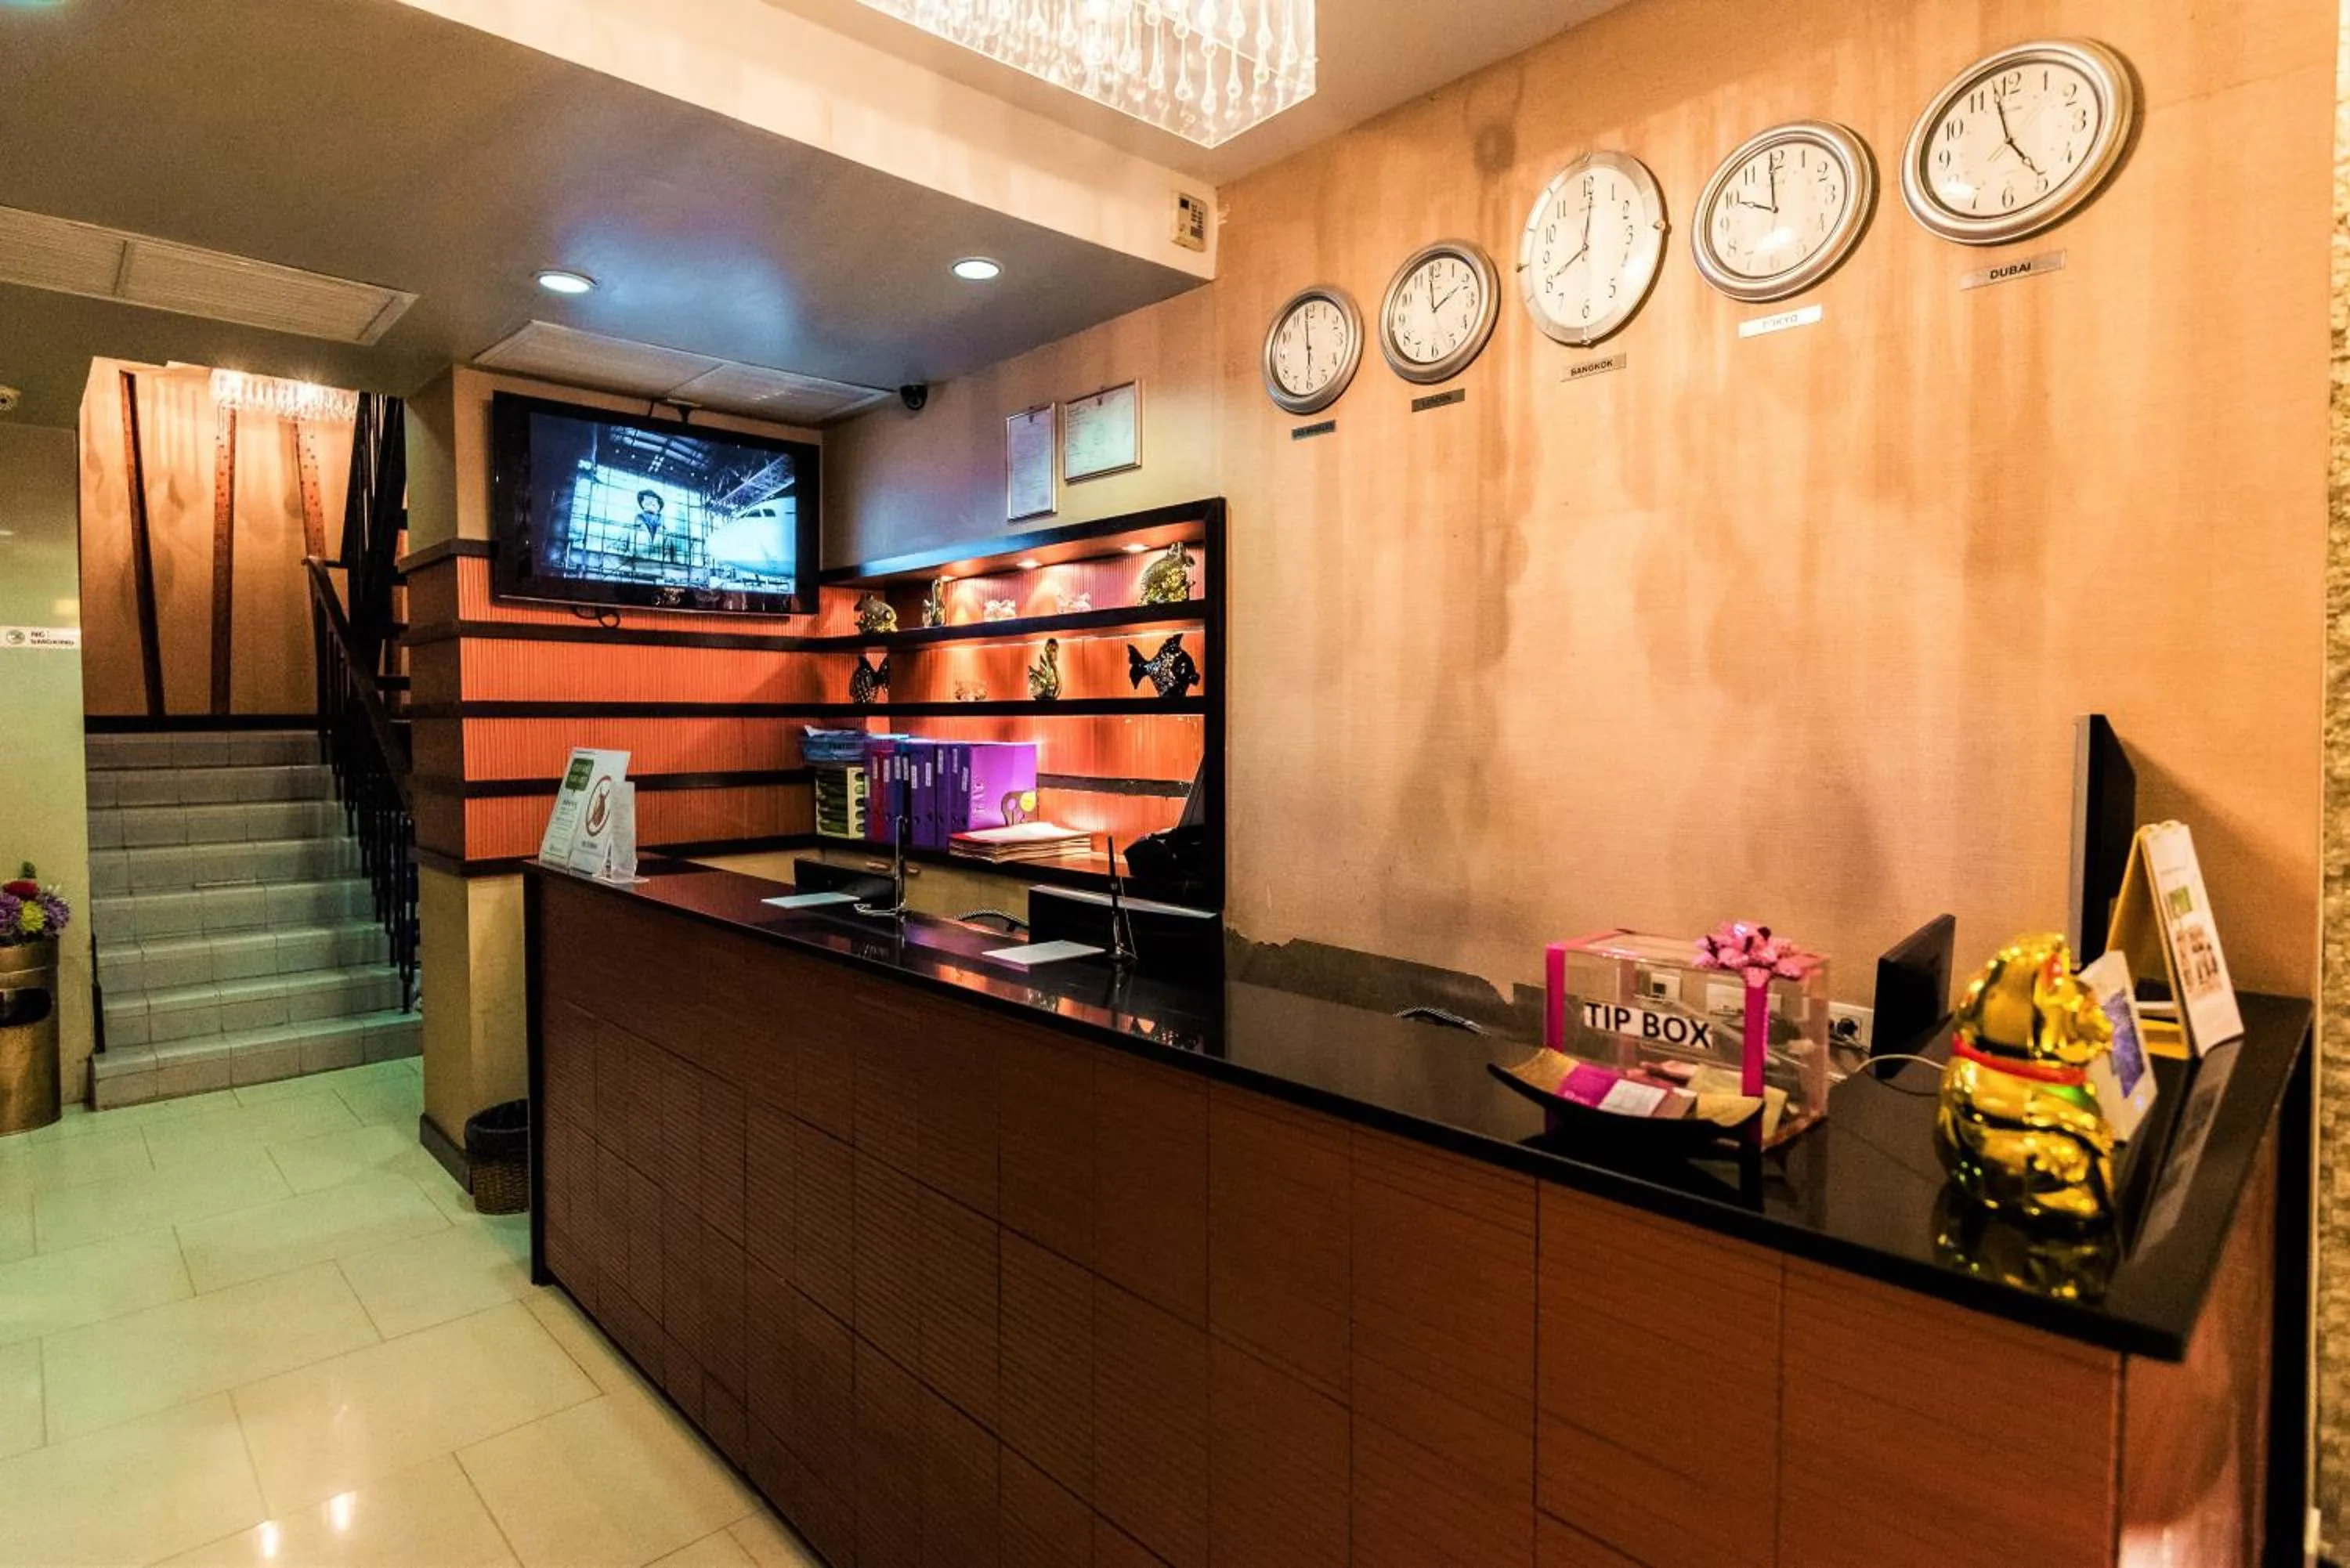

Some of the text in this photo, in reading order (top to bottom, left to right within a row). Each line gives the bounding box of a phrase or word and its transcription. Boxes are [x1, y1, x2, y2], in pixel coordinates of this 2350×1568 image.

[2002, 72, 2022, 96] 12
[2063, 83, 2077, 107] 2
[1970, 91, 1984, 113] 11
[1947, 119, 1963, 141] 10
[2073, 110, 2086, 133] 3
[1940, 150, 1951, 169] 9
[2036, 170, 2048, 192] 5
[1972, 187, 1980, 209] 7
[2001, 187, 2014, 208] 6
[1990, 262, 2031, 279] DUBAI
[1571, 359, 1613, 376] BANGKOK
[1585, 1003, 1709, 1049] TIP BOX
